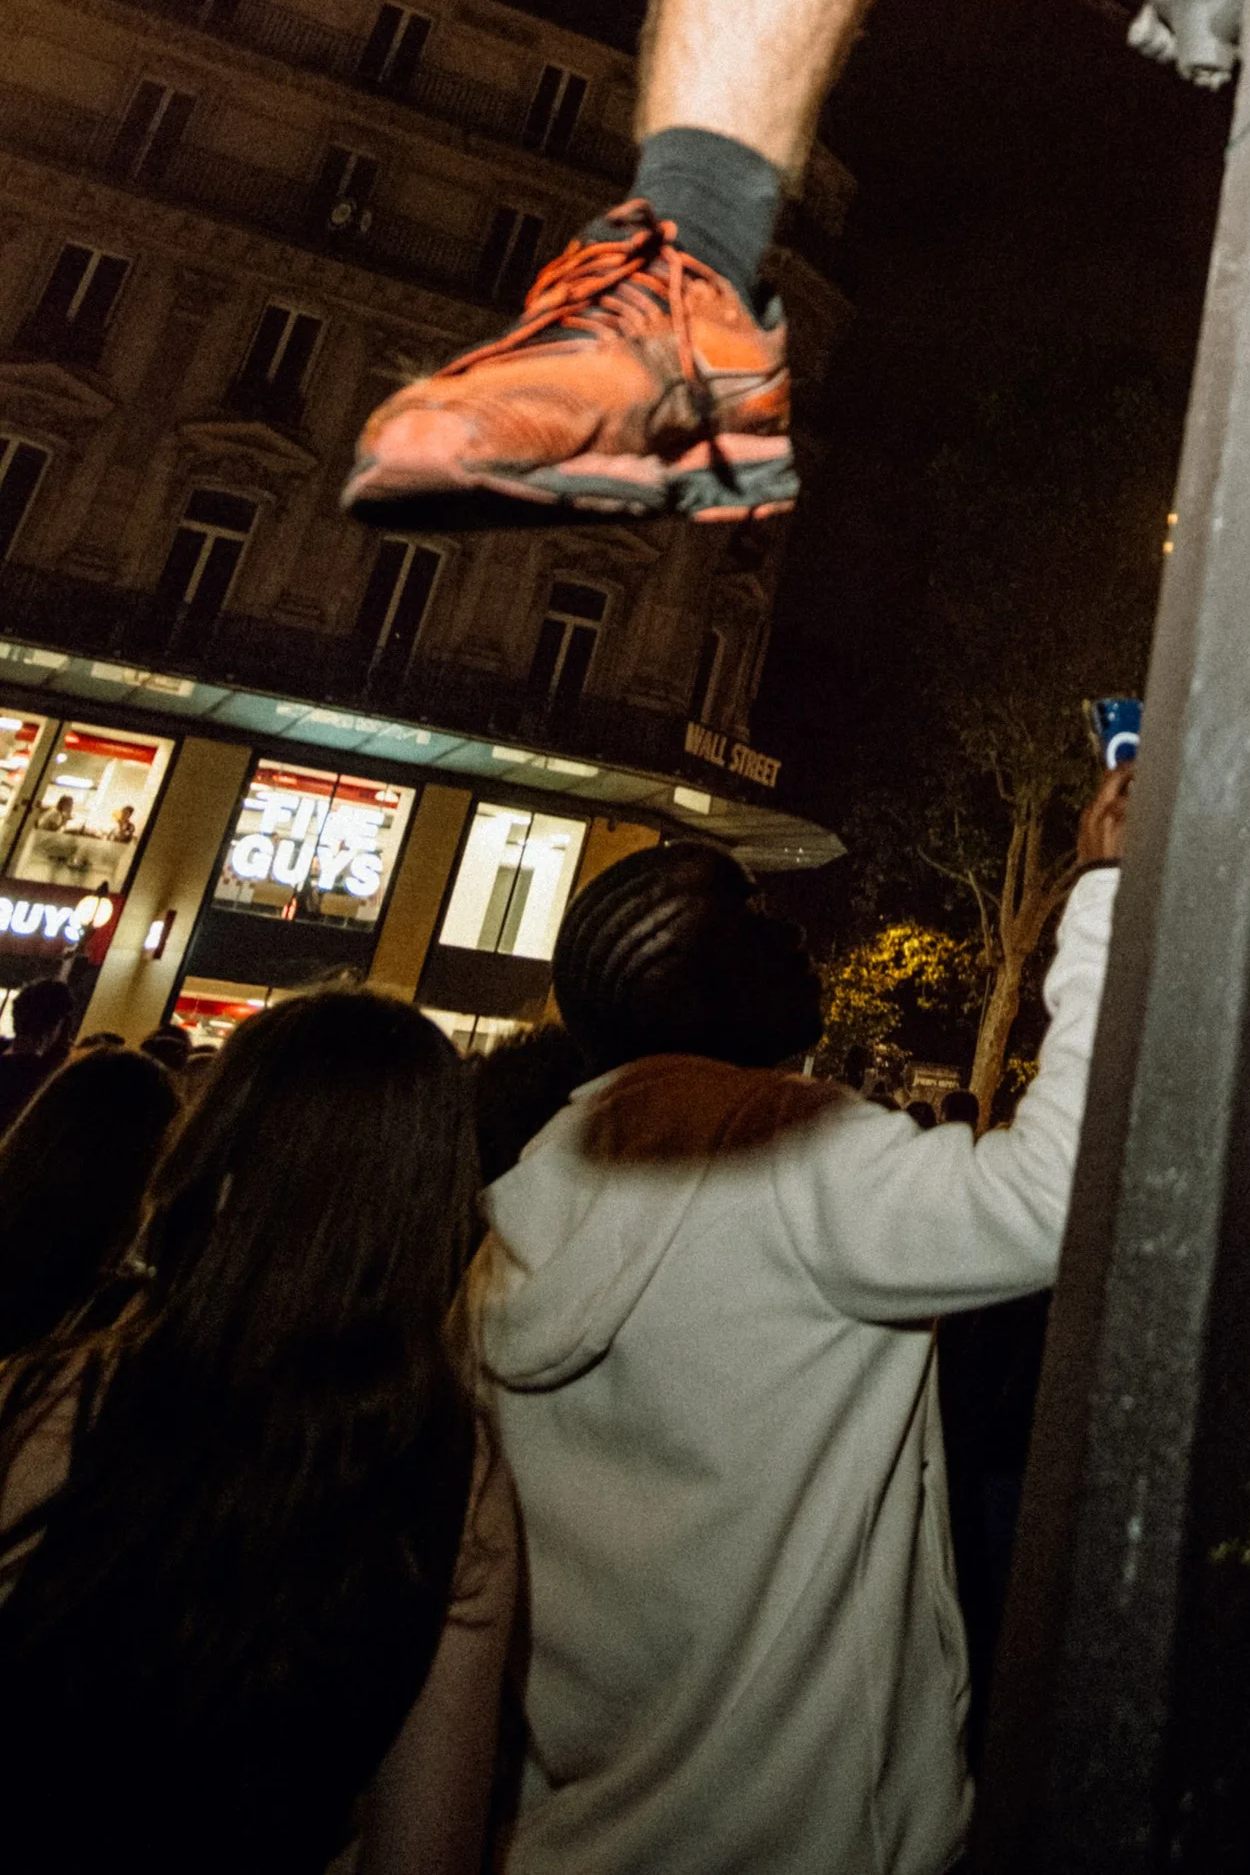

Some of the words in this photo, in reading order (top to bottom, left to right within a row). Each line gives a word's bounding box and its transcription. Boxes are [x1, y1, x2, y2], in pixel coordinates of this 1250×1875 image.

[684, 721, 727, 767] WALL
[728, 742, 782, 789] STREET
[256, 789, 385, 852] FIVE
[231, 833, 383, 898] GUYS
